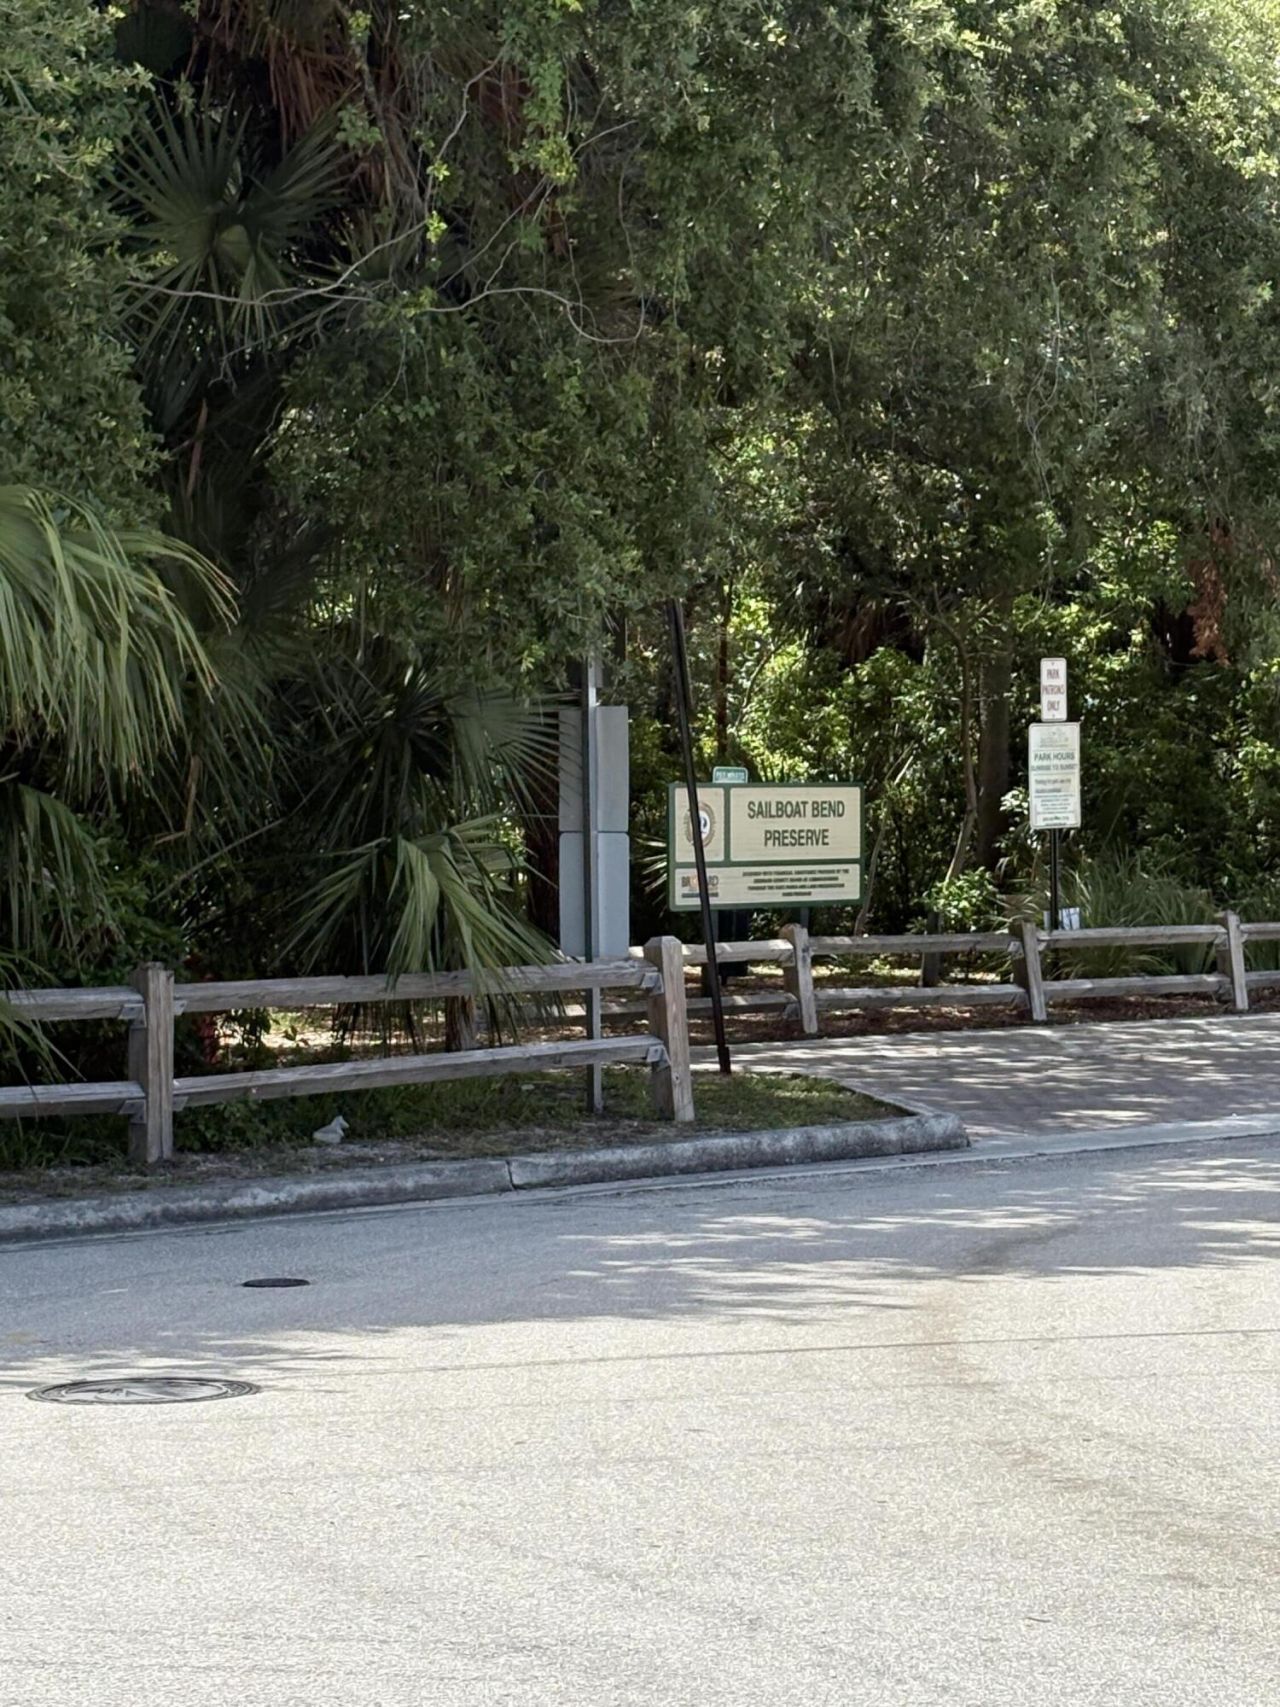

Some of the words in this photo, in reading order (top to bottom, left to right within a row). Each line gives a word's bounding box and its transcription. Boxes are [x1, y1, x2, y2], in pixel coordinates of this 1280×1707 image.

[1047, 669, 1059, 679] PARK
[1047, 700, 1059, 711] ONLY
[1034, 752, 1051, 761] PARK
[1053, 751, 1075, 760] HOURS
[747, 800, 808, 819] SAILBOAT
[812, 800, 845, 818] BEND
[764, 829, 829, 847] PRESERVE
